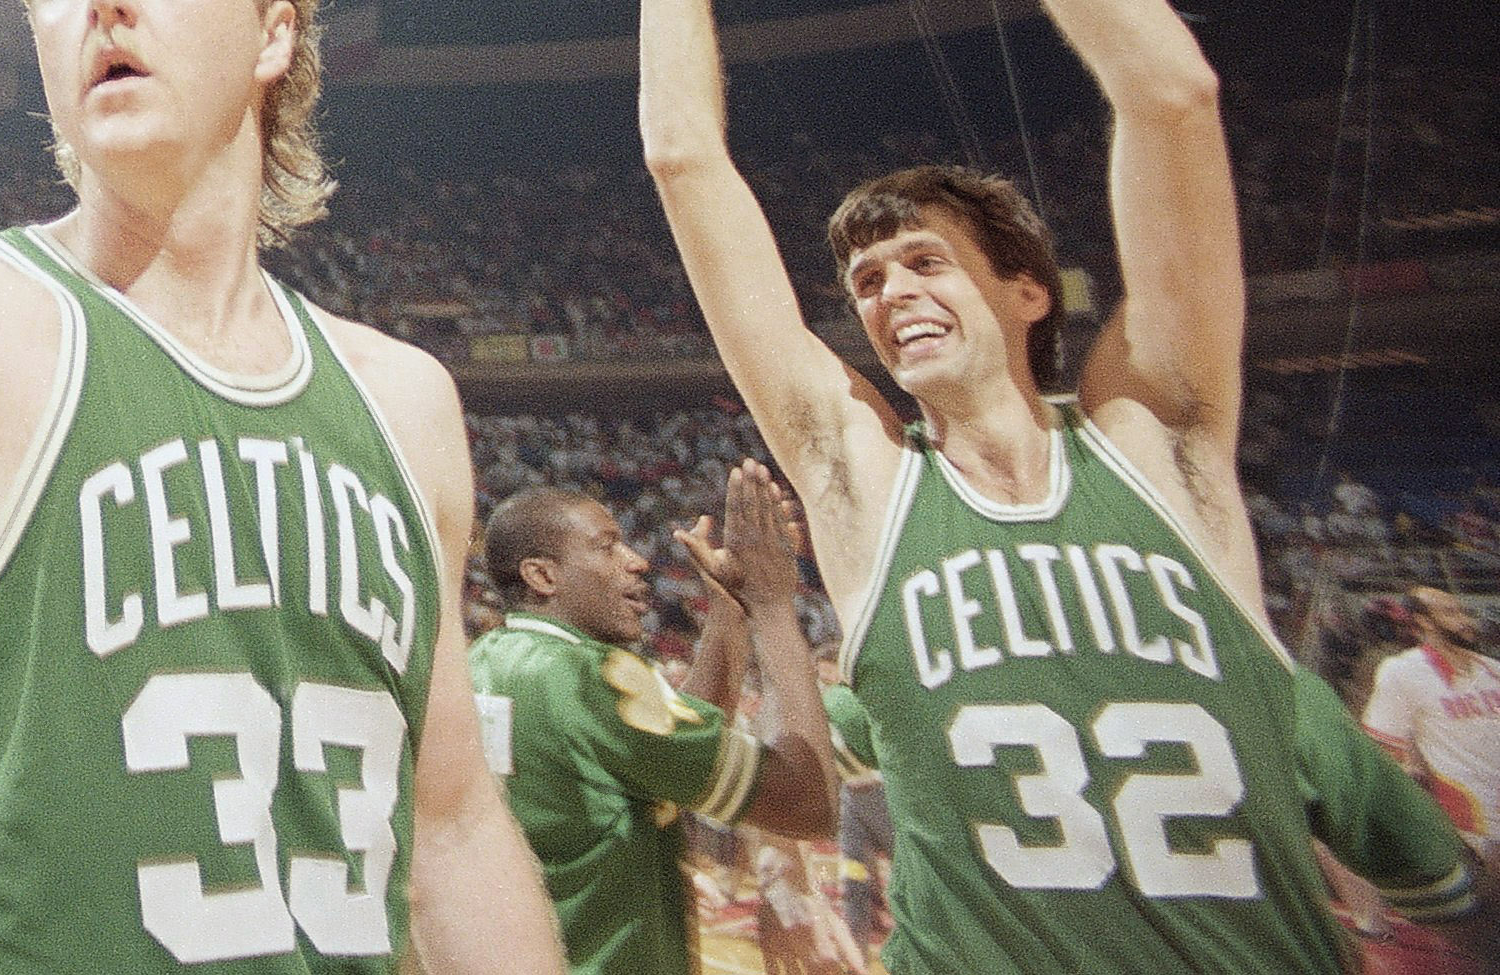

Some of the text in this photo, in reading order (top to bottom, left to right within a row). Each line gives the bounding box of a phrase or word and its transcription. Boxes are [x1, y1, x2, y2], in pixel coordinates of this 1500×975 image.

[79, 436, 415, 675] CELTICS
[902, 543, 1222, 689] CELTICS
[122, 671, 408, 964] 33
[948, 702, 1264, 899] 32
